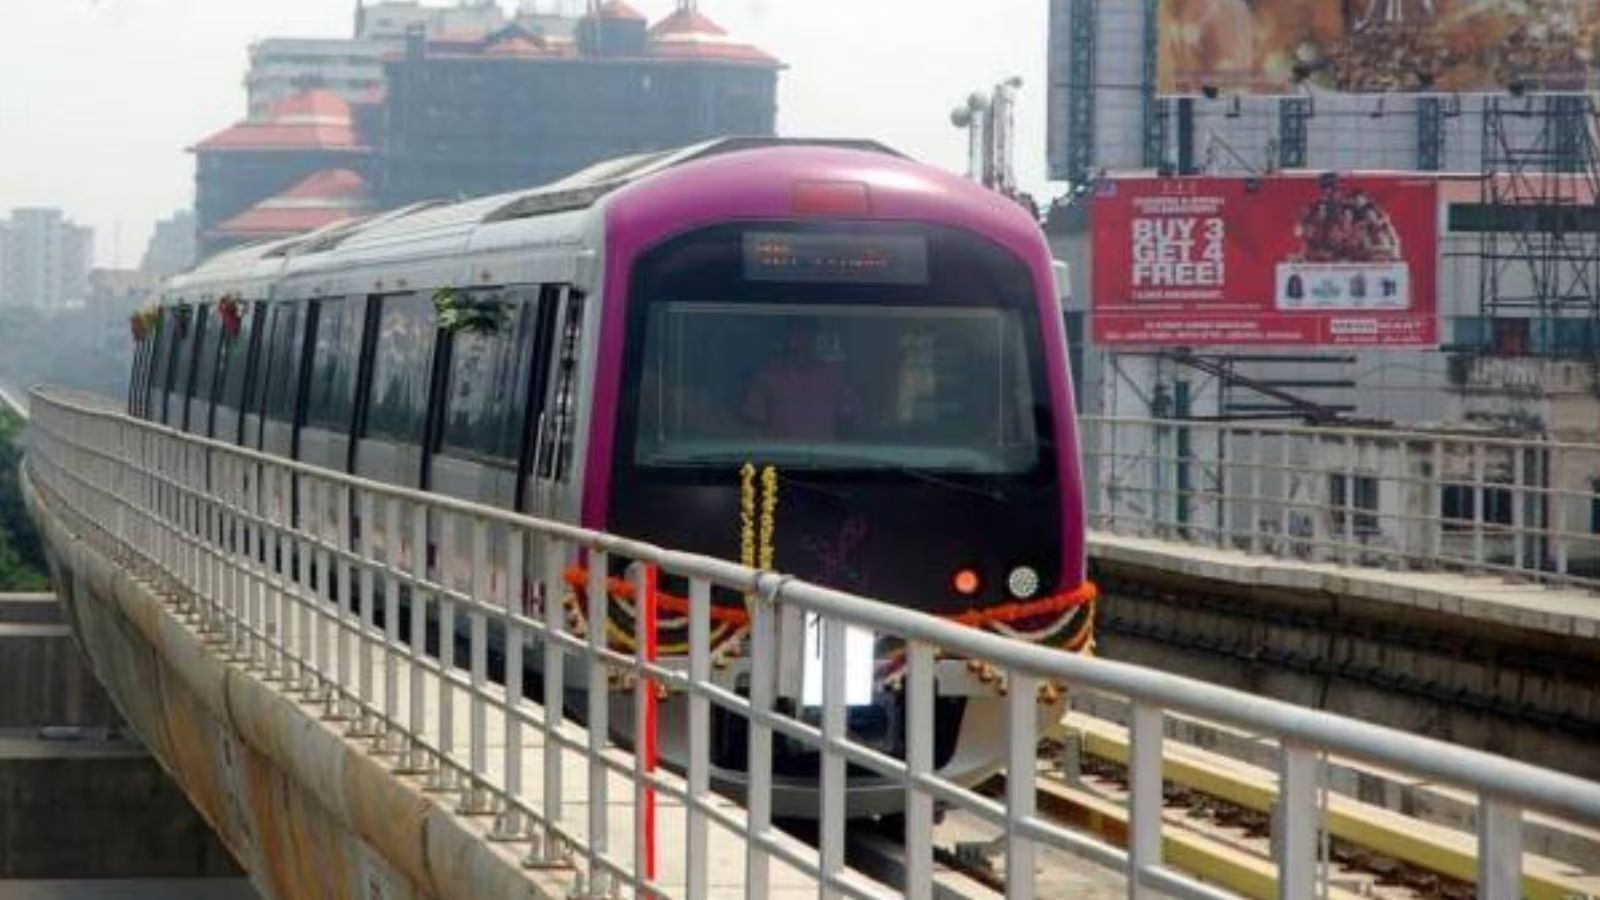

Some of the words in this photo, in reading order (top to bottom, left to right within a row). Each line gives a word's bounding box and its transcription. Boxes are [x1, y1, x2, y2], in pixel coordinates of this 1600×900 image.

[1132, 217, 1197, 240] BUY
[1203, 217, 1224, 240] 3
[1132, 239, 1196, 262] GET
[1202, 240, 1224, 262] 4
[1132, 261, 1225, 286] FREE!
